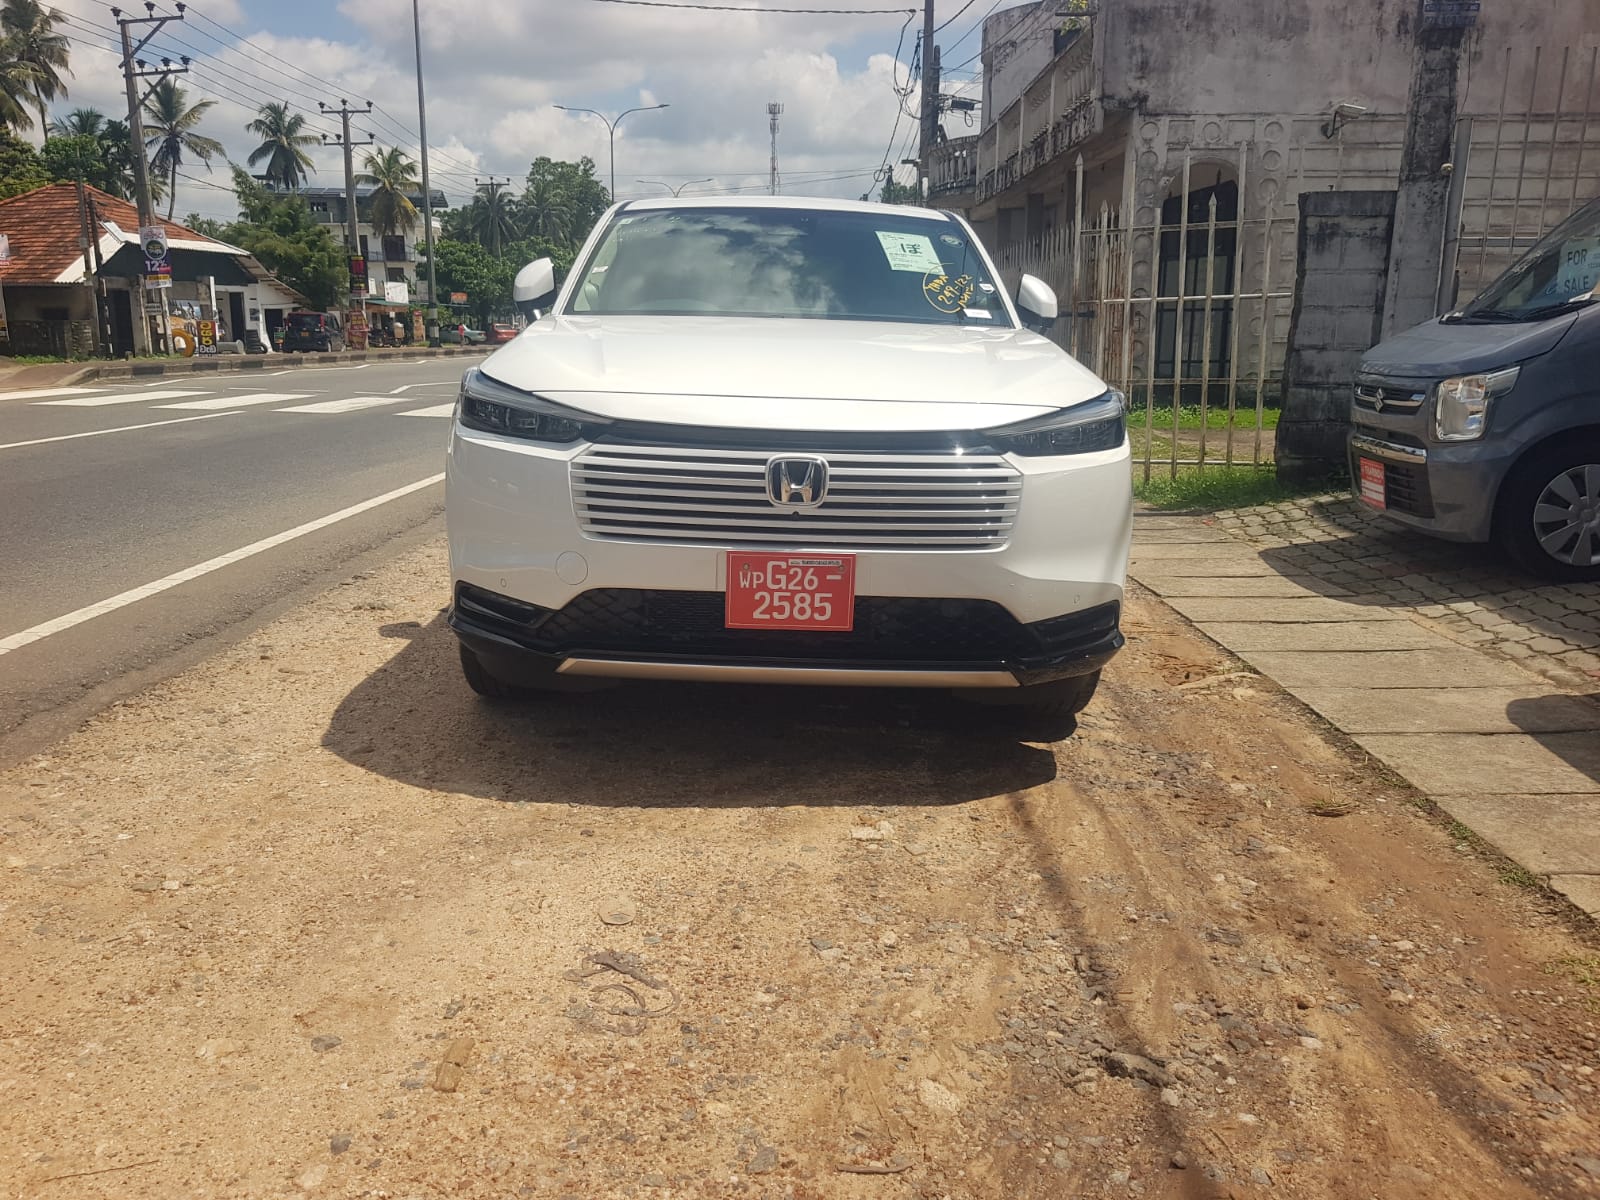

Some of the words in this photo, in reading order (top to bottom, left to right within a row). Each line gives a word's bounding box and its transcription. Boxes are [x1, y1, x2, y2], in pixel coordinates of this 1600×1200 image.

[1567, 249, 1588, 265] FOR
[1564, 276, 1590, 293] SALE
[752, 591, 833, 621] 2585
